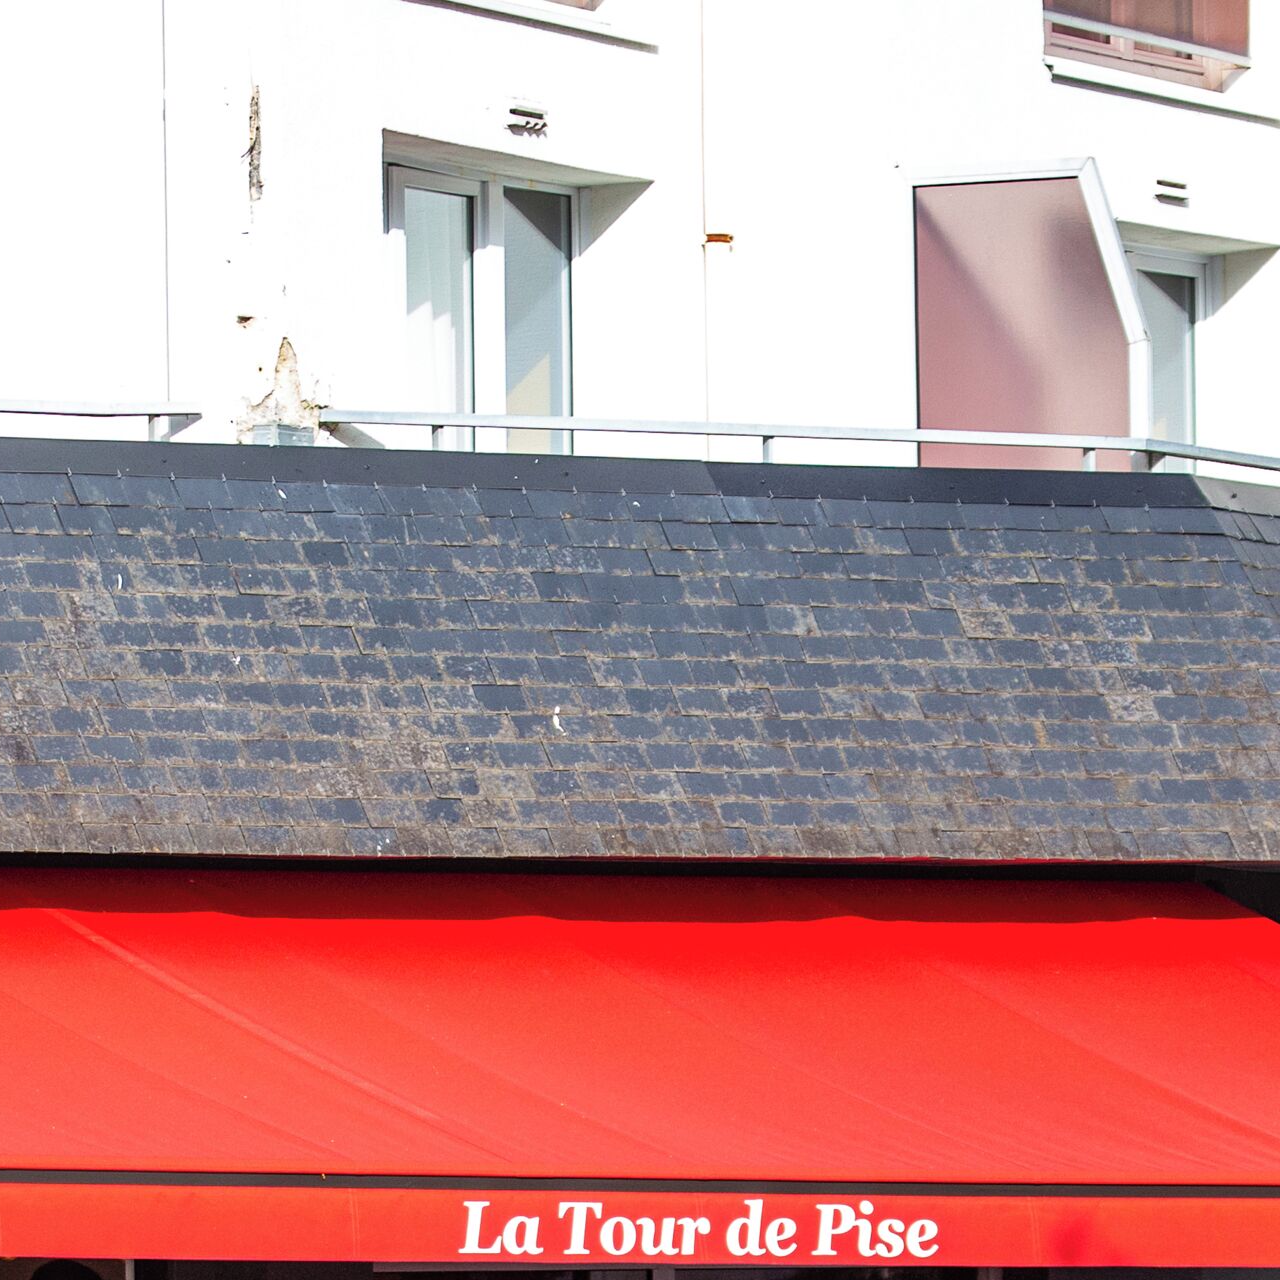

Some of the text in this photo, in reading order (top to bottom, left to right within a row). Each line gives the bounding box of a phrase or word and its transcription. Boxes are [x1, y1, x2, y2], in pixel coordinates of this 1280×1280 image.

[458, 1198, 940, 1258] La Tour de Pise
